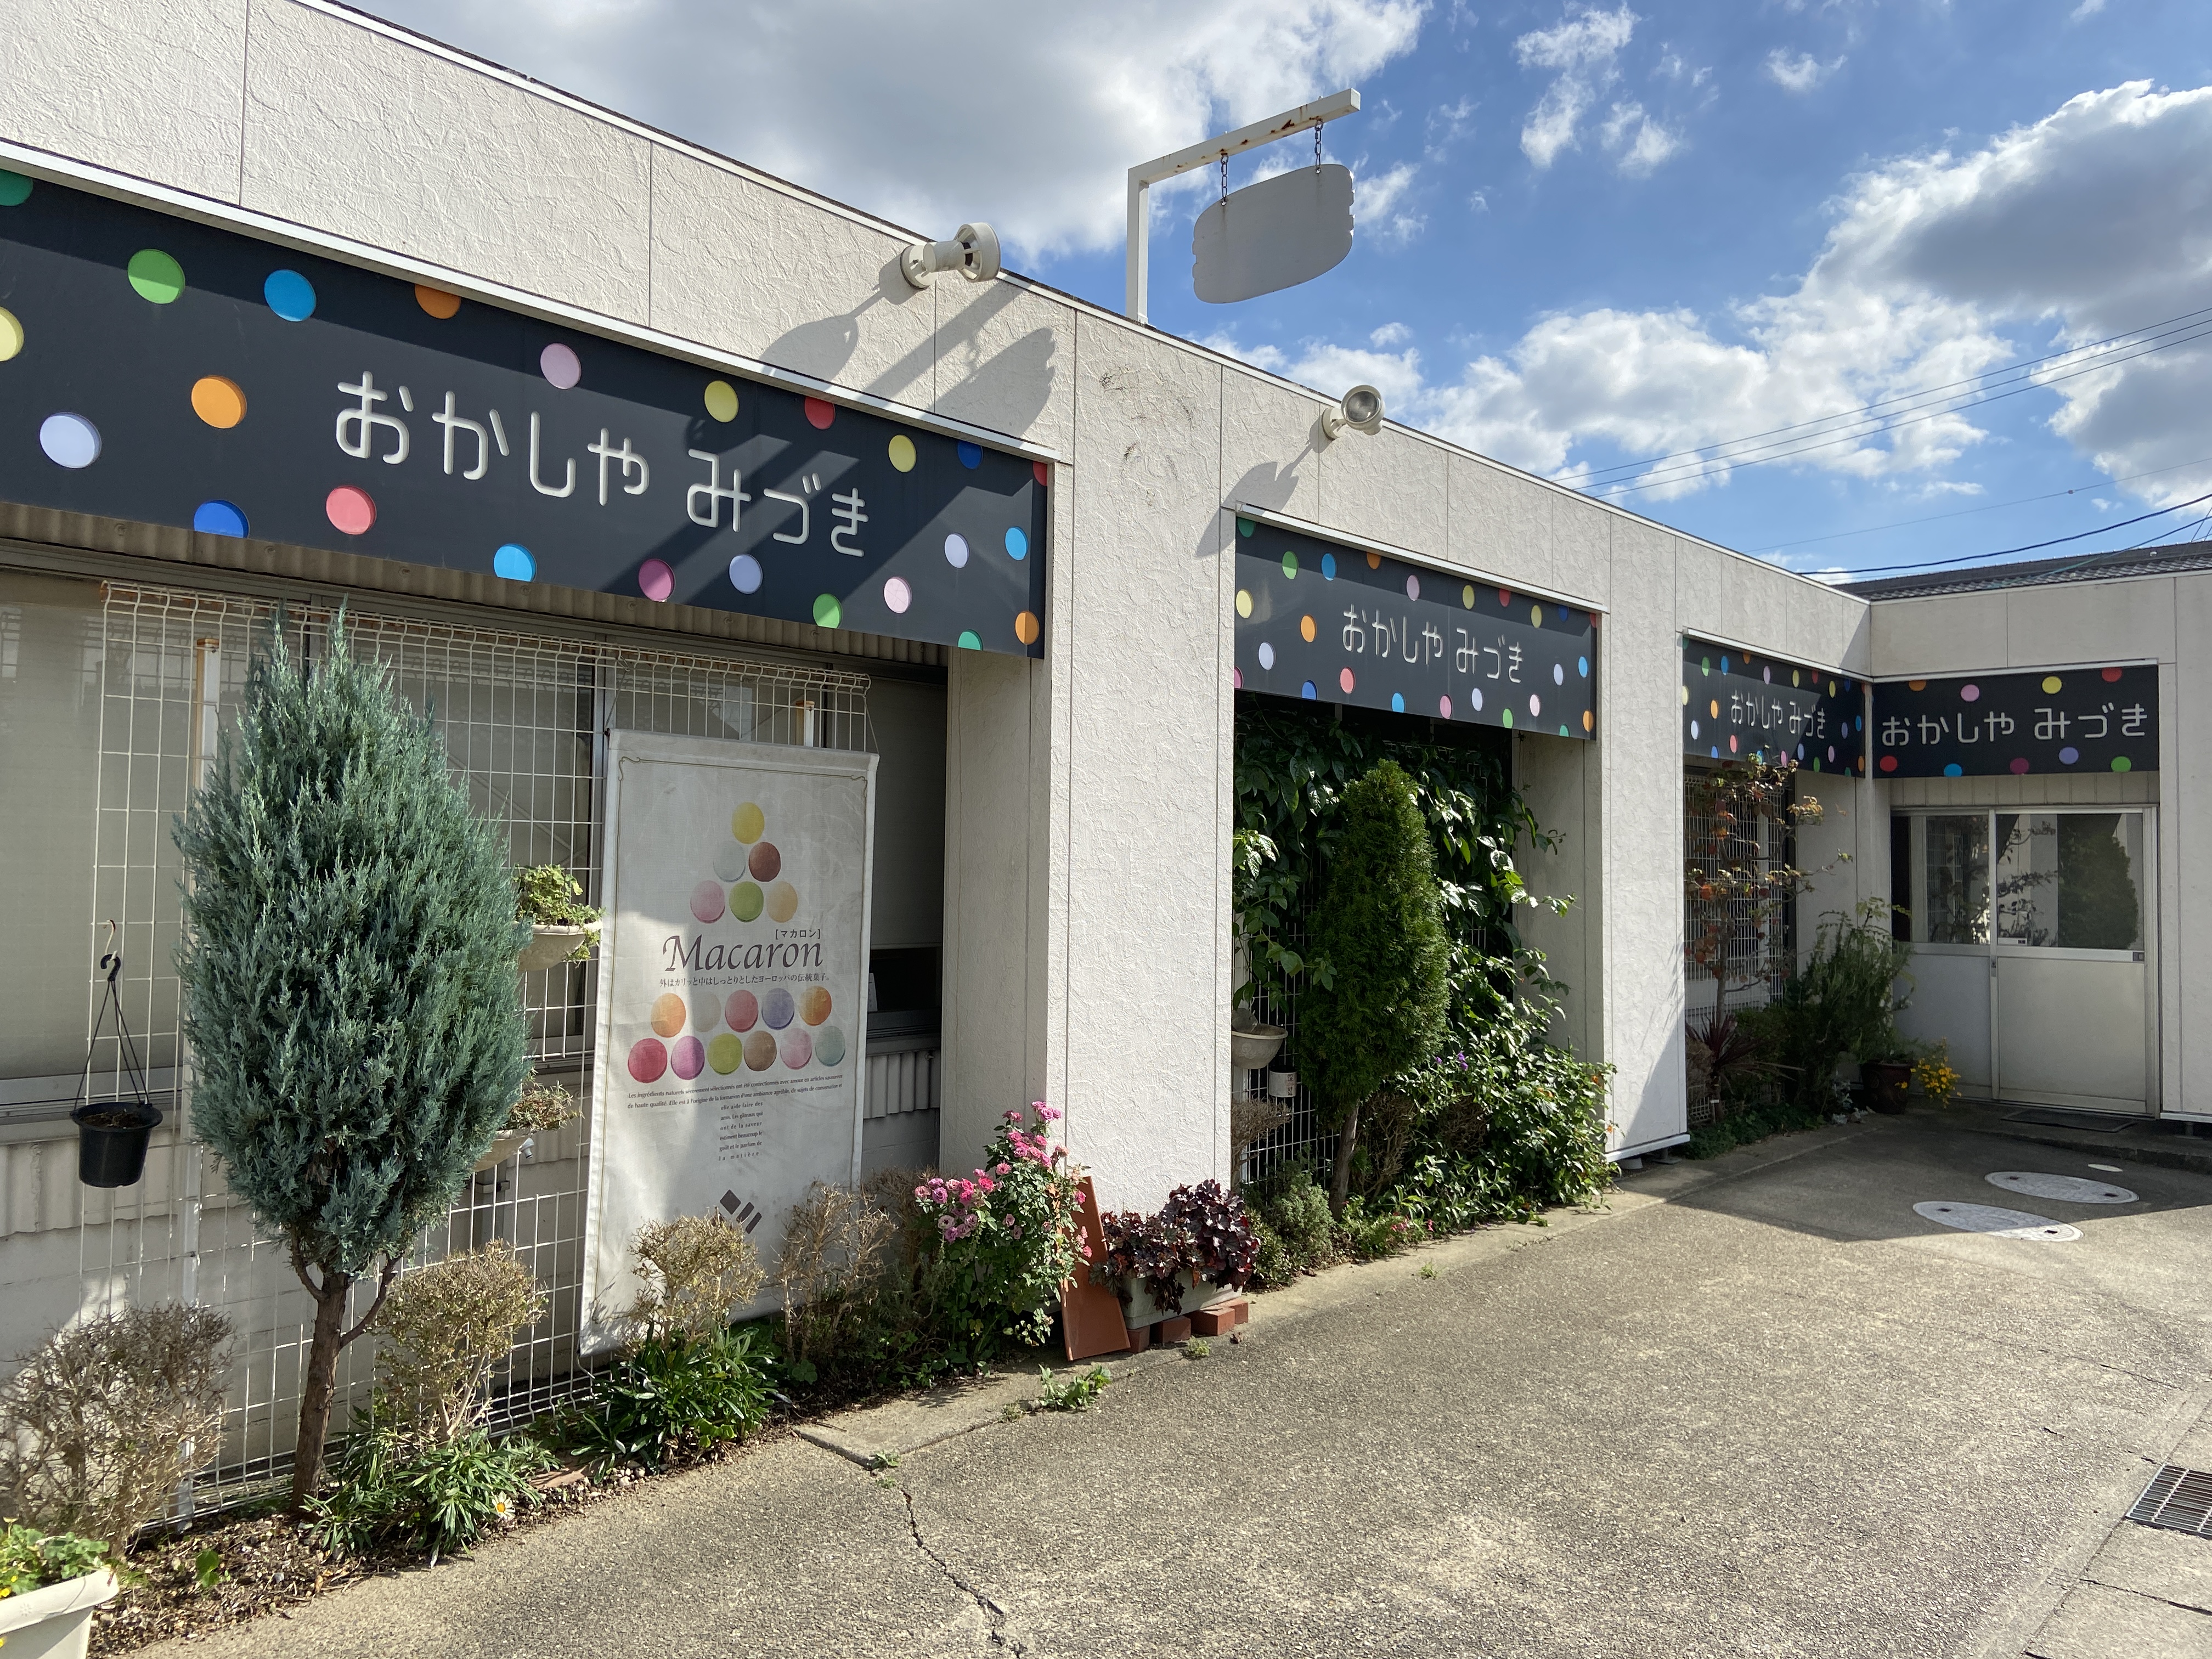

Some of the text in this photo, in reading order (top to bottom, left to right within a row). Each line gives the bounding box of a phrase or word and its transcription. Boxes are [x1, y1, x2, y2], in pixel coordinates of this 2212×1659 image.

[335, 370, 869, 557] おかしや みづき
[1342, 603, 1523, 684] おかしや みづき
[1731, 689, 1825, 739] おかしや みづき
[1882, 702, 2148, 746] おかしや みづき
[663, 934, 823, 972] Macaron
